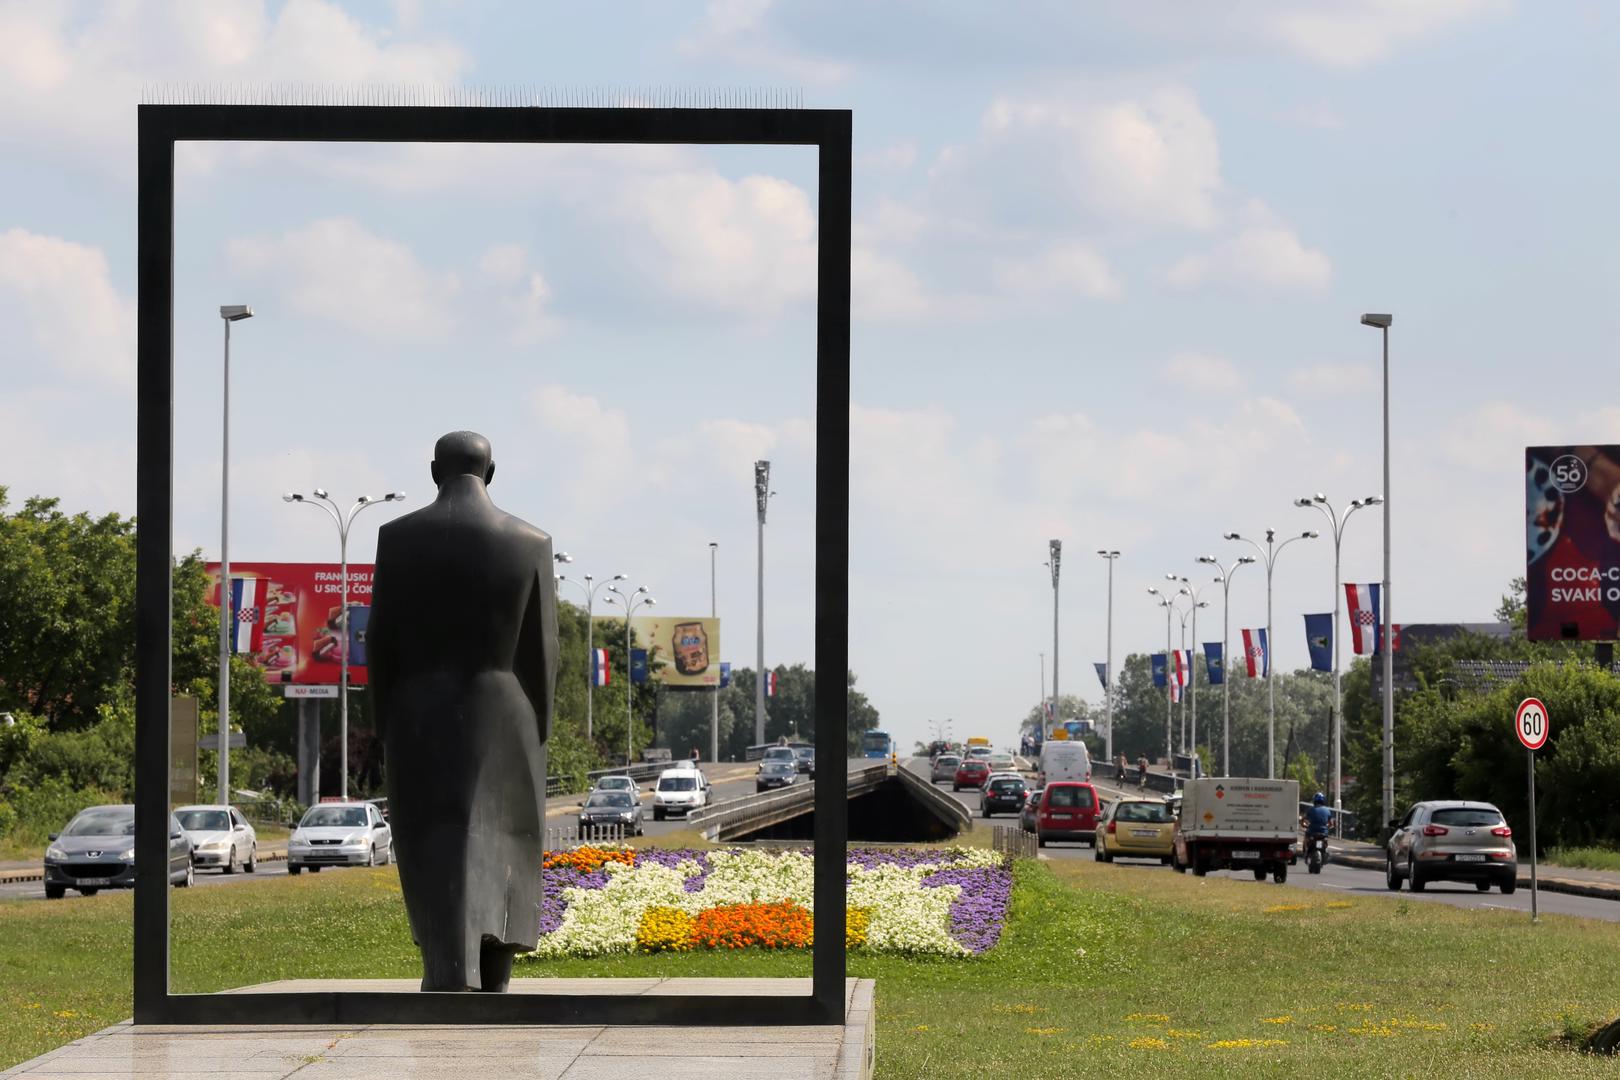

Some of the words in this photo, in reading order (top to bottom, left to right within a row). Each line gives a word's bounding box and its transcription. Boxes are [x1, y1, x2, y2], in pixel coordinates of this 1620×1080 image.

[314, 572, 368, 581] FRANUSKI
[1551, 566, 1620, 581] COCA-C
[314, 584, 323, 593] U
[1551, 587, 1602, 602] SVAKI
[1523, 712, 1541, 736] 60
